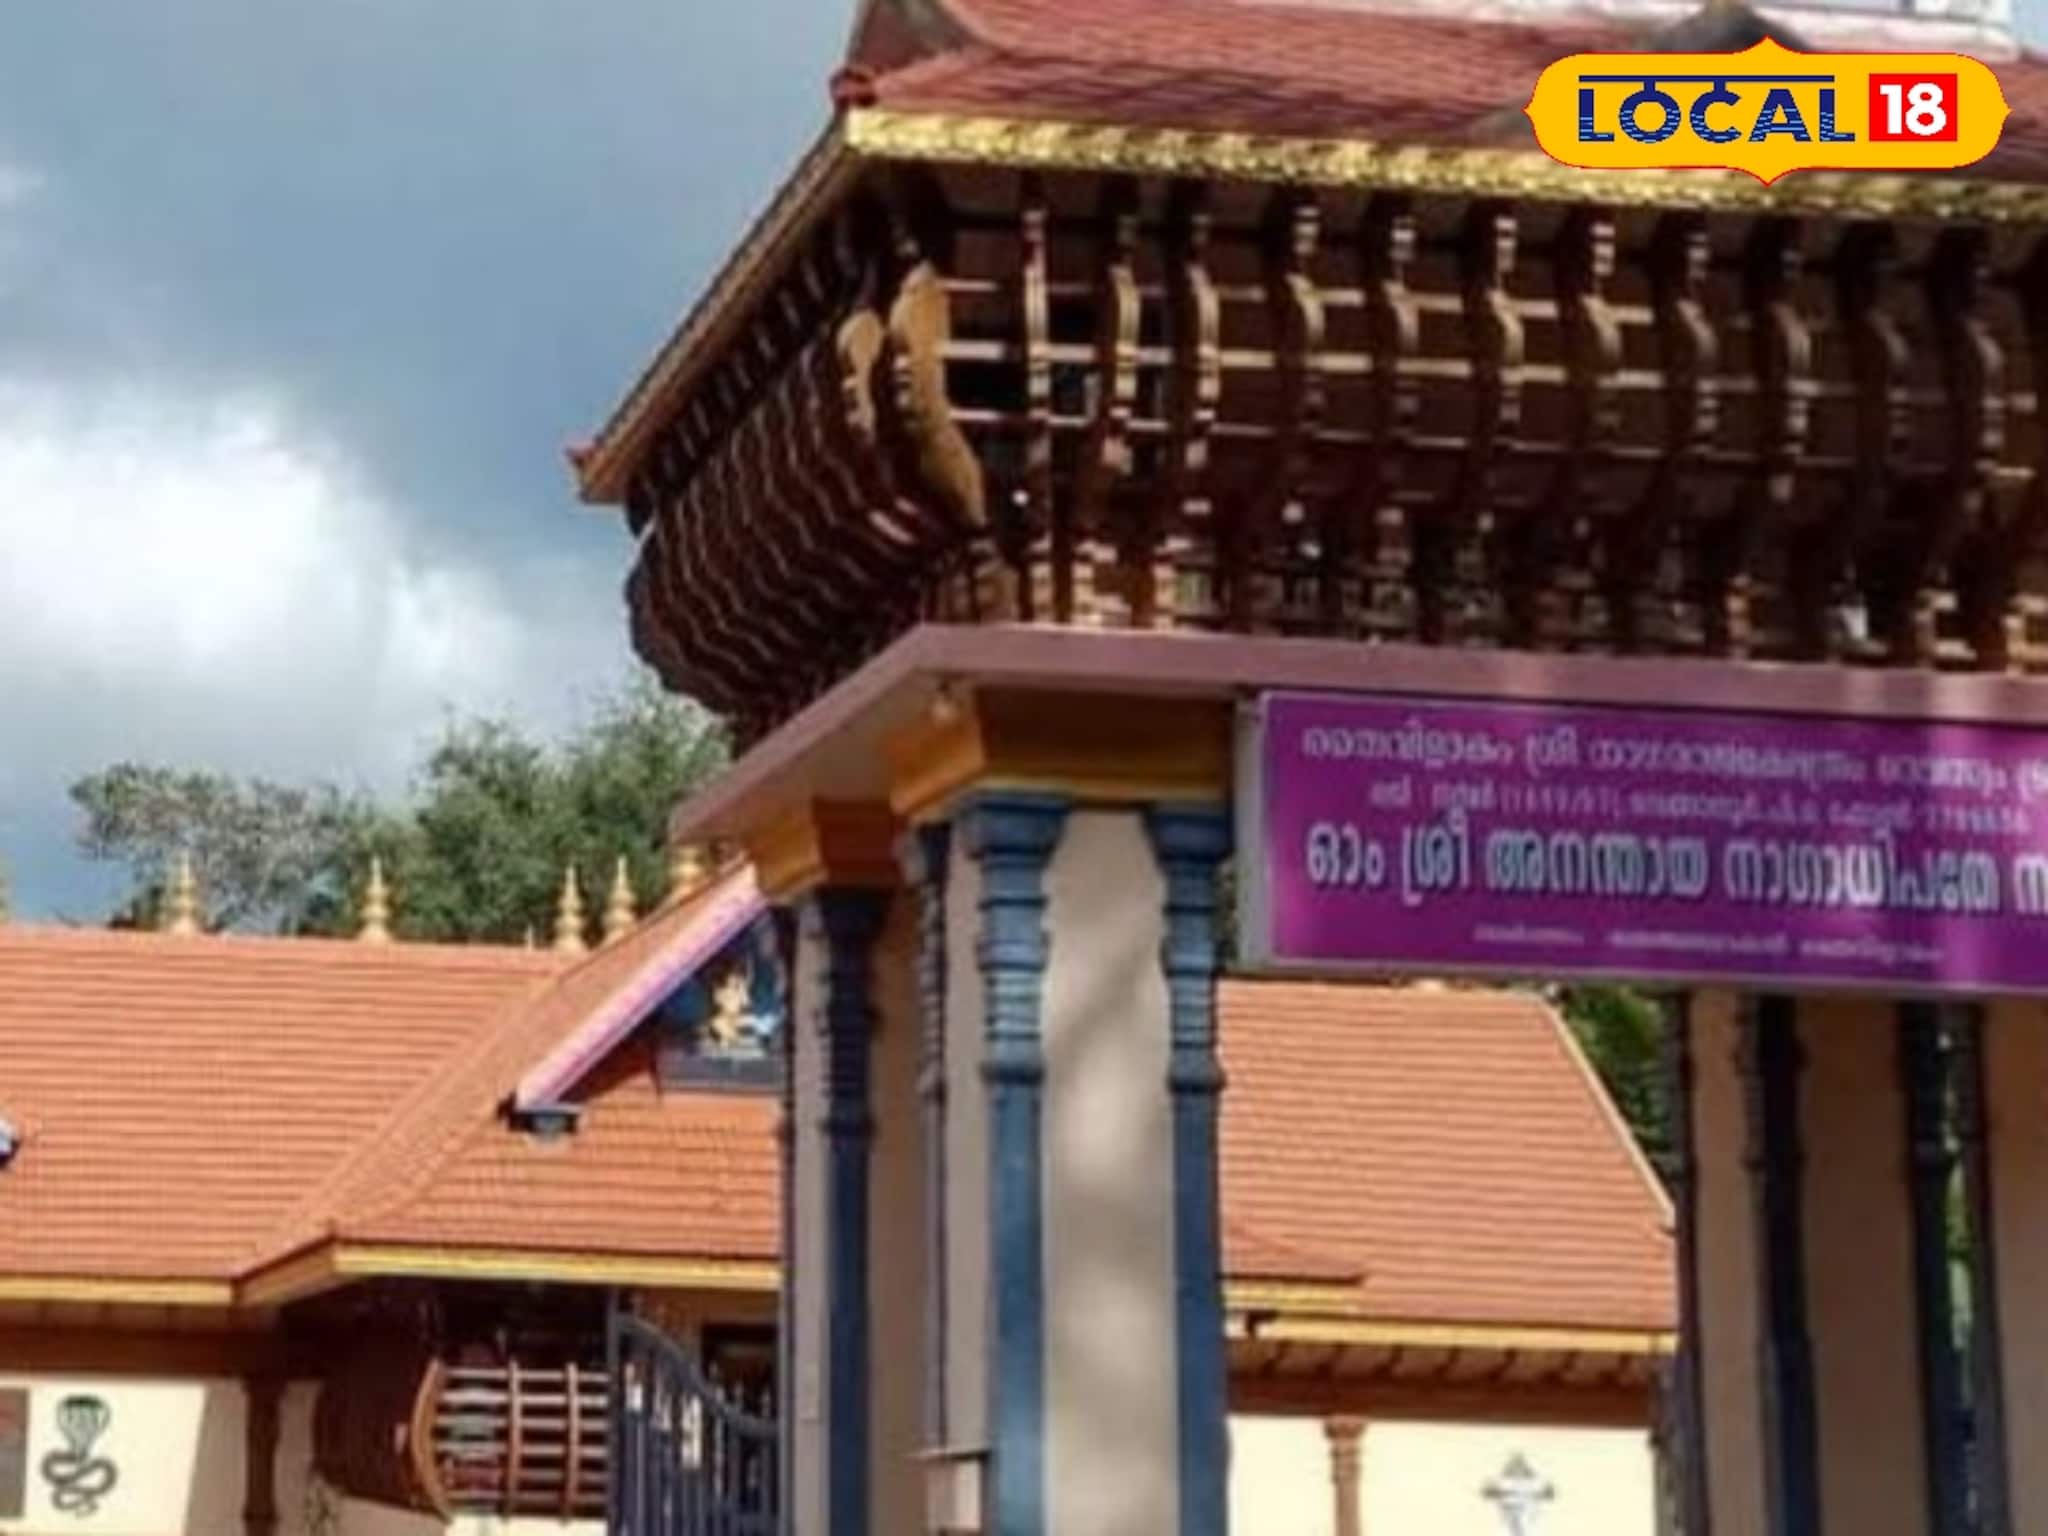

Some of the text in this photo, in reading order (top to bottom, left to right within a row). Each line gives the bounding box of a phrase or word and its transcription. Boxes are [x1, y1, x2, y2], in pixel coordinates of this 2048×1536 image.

[1307, 820, 1385, 886] ഓം
[1402, 806, 1470, 906] ശ്രീ
[1484, 827, 1709, 897] അനന്തായ
